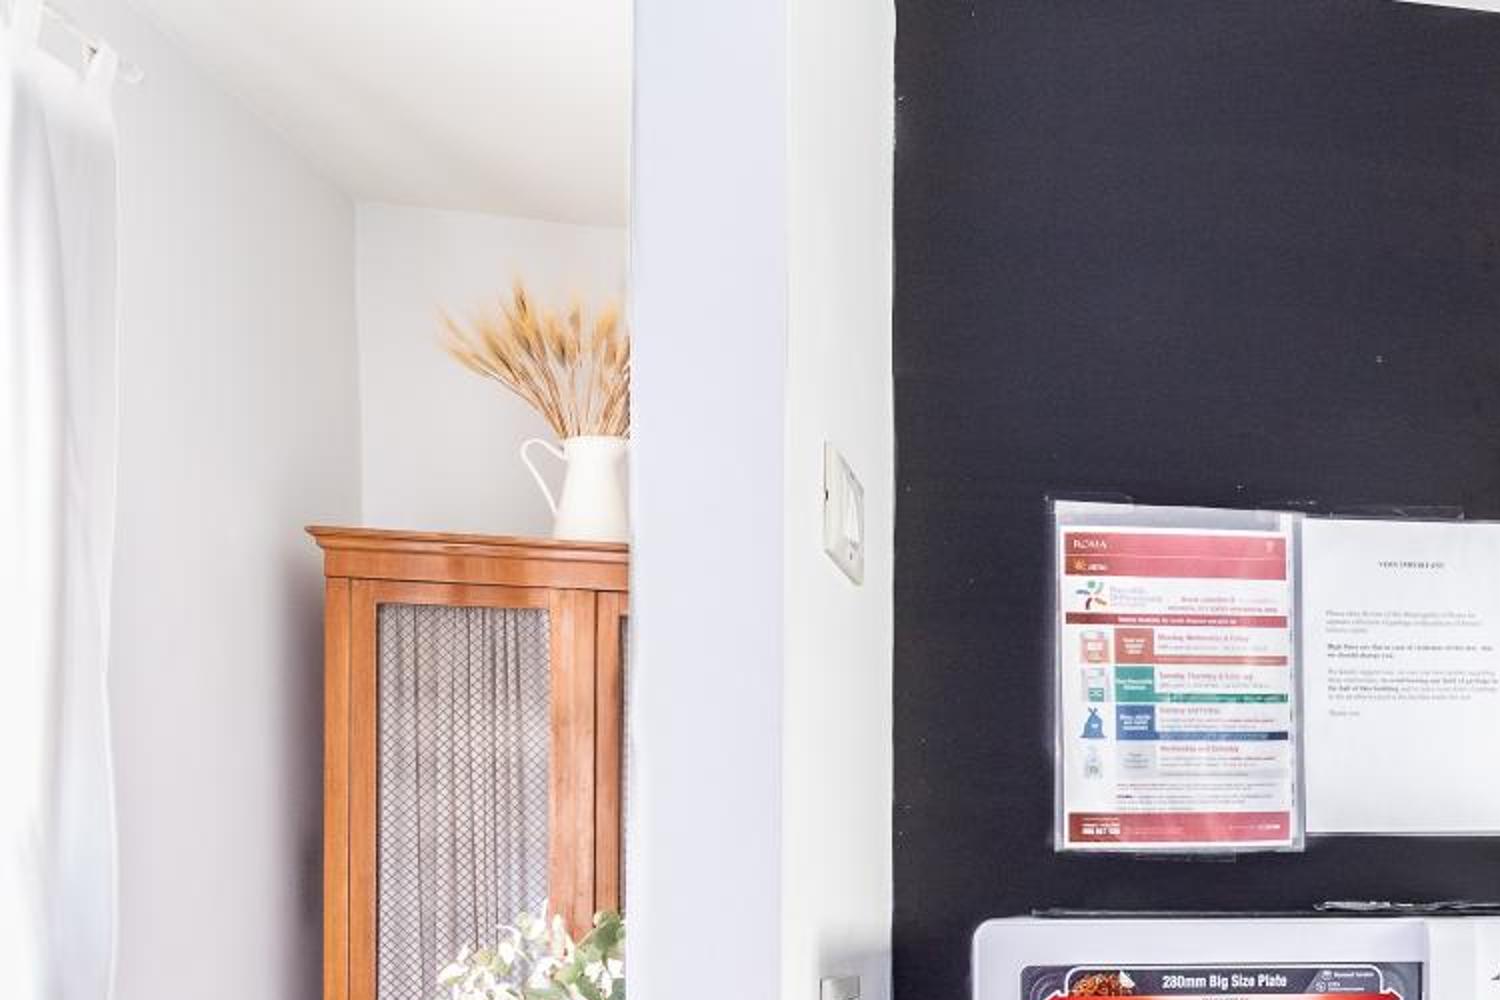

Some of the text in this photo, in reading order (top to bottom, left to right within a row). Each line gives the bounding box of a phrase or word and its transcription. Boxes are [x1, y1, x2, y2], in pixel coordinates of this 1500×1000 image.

[1162, 973, 1287, 990] 280mm Big Size Plate
